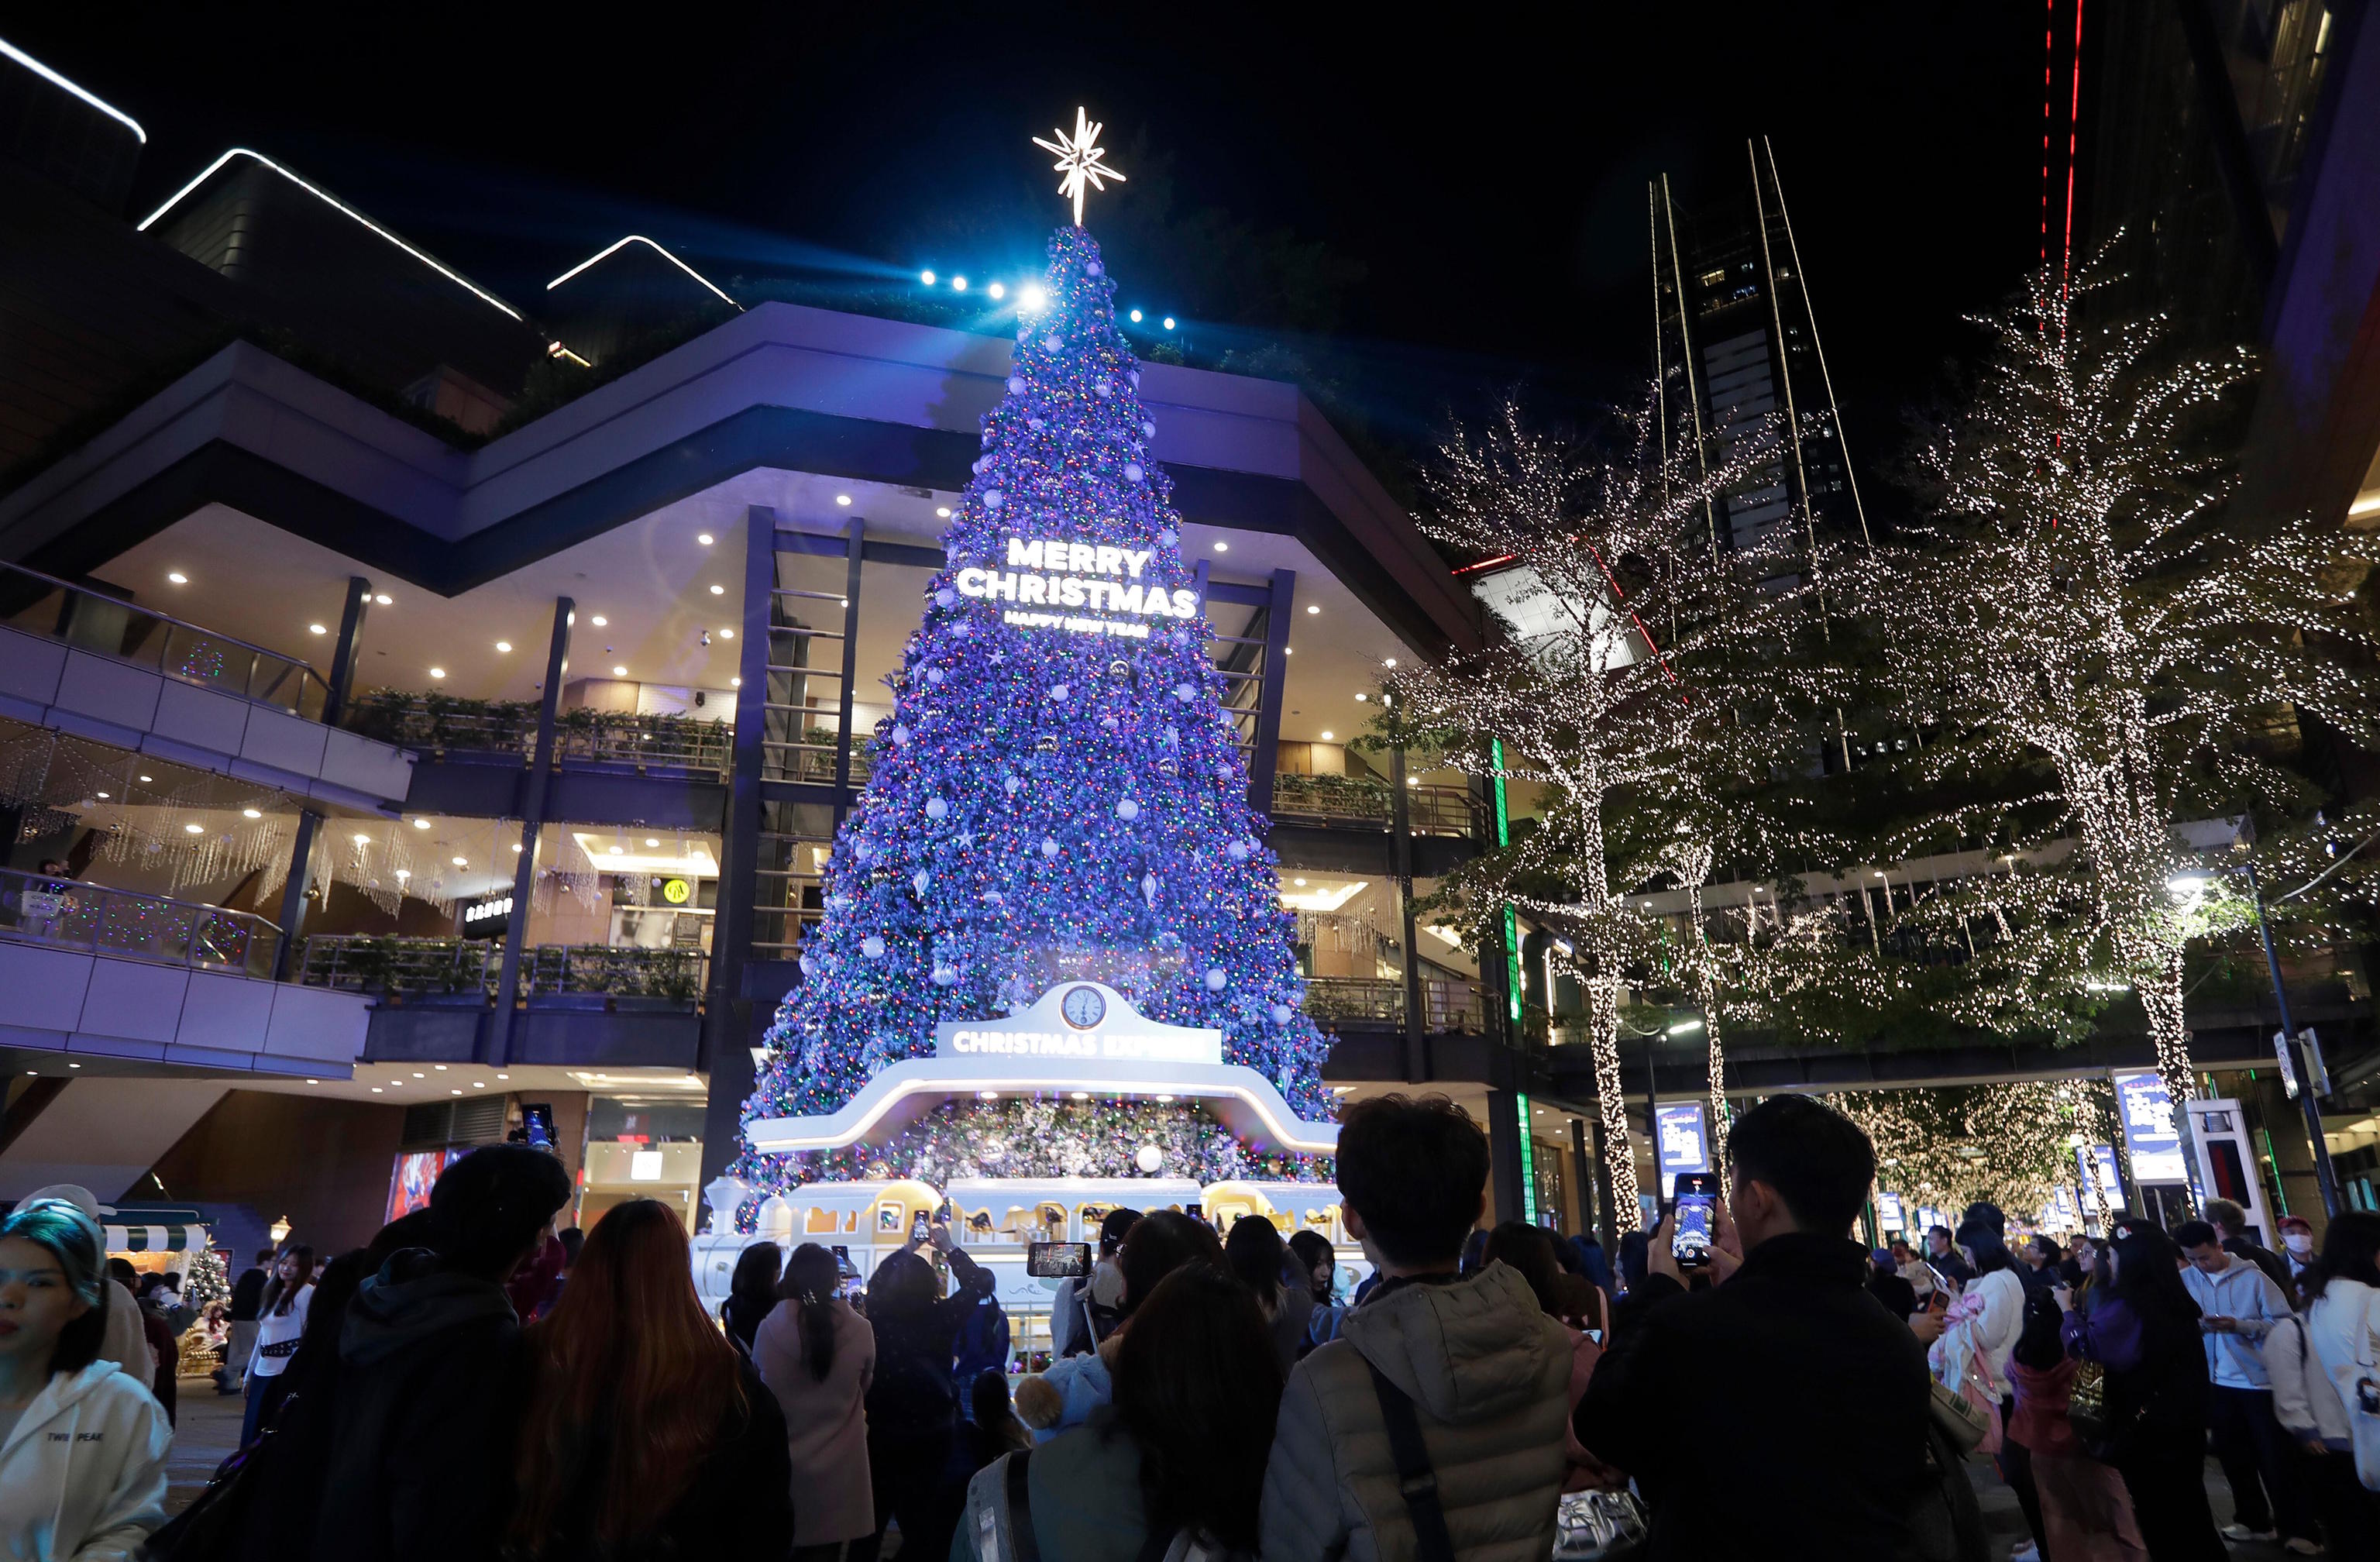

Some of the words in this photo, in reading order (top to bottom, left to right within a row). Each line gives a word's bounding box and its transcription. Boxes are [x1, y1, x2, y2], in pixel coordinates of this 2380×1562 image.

[1008, 538, 1151, 578] MERRY
[956, 567, 1198, 619] CHRISTMAS
[1004, 610, 1064, 629] HAPPY
[952, 1030, 1098, 1056] CHRISTMAS
